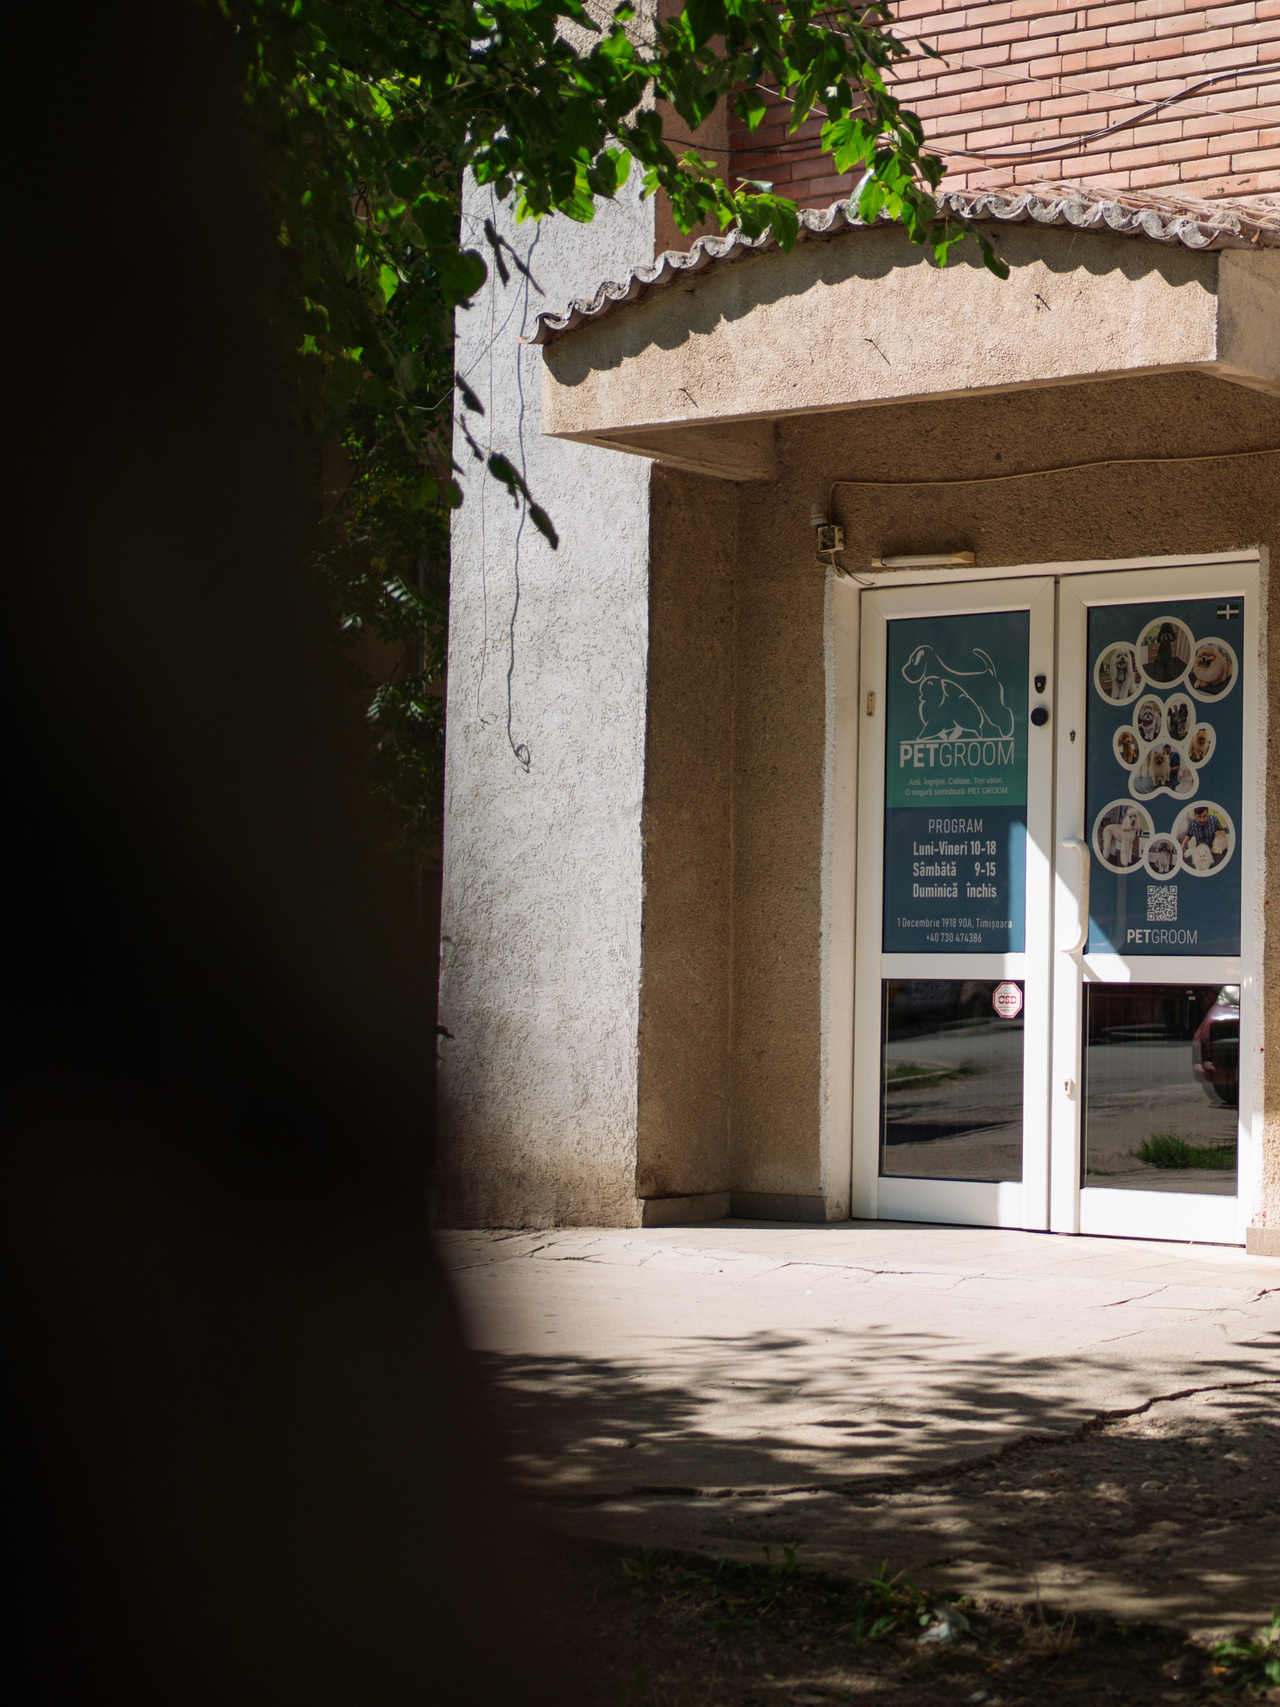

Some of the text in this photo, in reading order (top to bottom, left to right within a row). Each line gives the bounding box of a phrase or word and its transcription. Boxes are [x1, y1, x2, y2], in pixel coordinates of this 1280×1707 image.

[900, 741, 1014, 768] PETGROOM
[974, 776, 985, 784] Trei
[986, 776, 1004, 784] valori.
[912, 788, 932, 797] singură
[933, 787, 966, 796] semnătură:
[967, 787, 980, 795] PET
[981, 786, 1008, 795] GROOM
[928, 818, 983, 833] PROGRAM
[913, 840, 997, 856] Luni-Vineri 10-18
[913, 861, 996, 877] Sâmbătă 9-15
[912, 882, 997, 898] Duminică închis
[902, 917, 940, 928] Decembrie
[942, 918, 957, 928] 1918
[958, 918, 975, 929] 90A,
[976, 918, 1013, 930] Timișoara
[926, 932, 982, 943] +40 730 474386
[1127, 929, 1198, 944] PETGROOM
